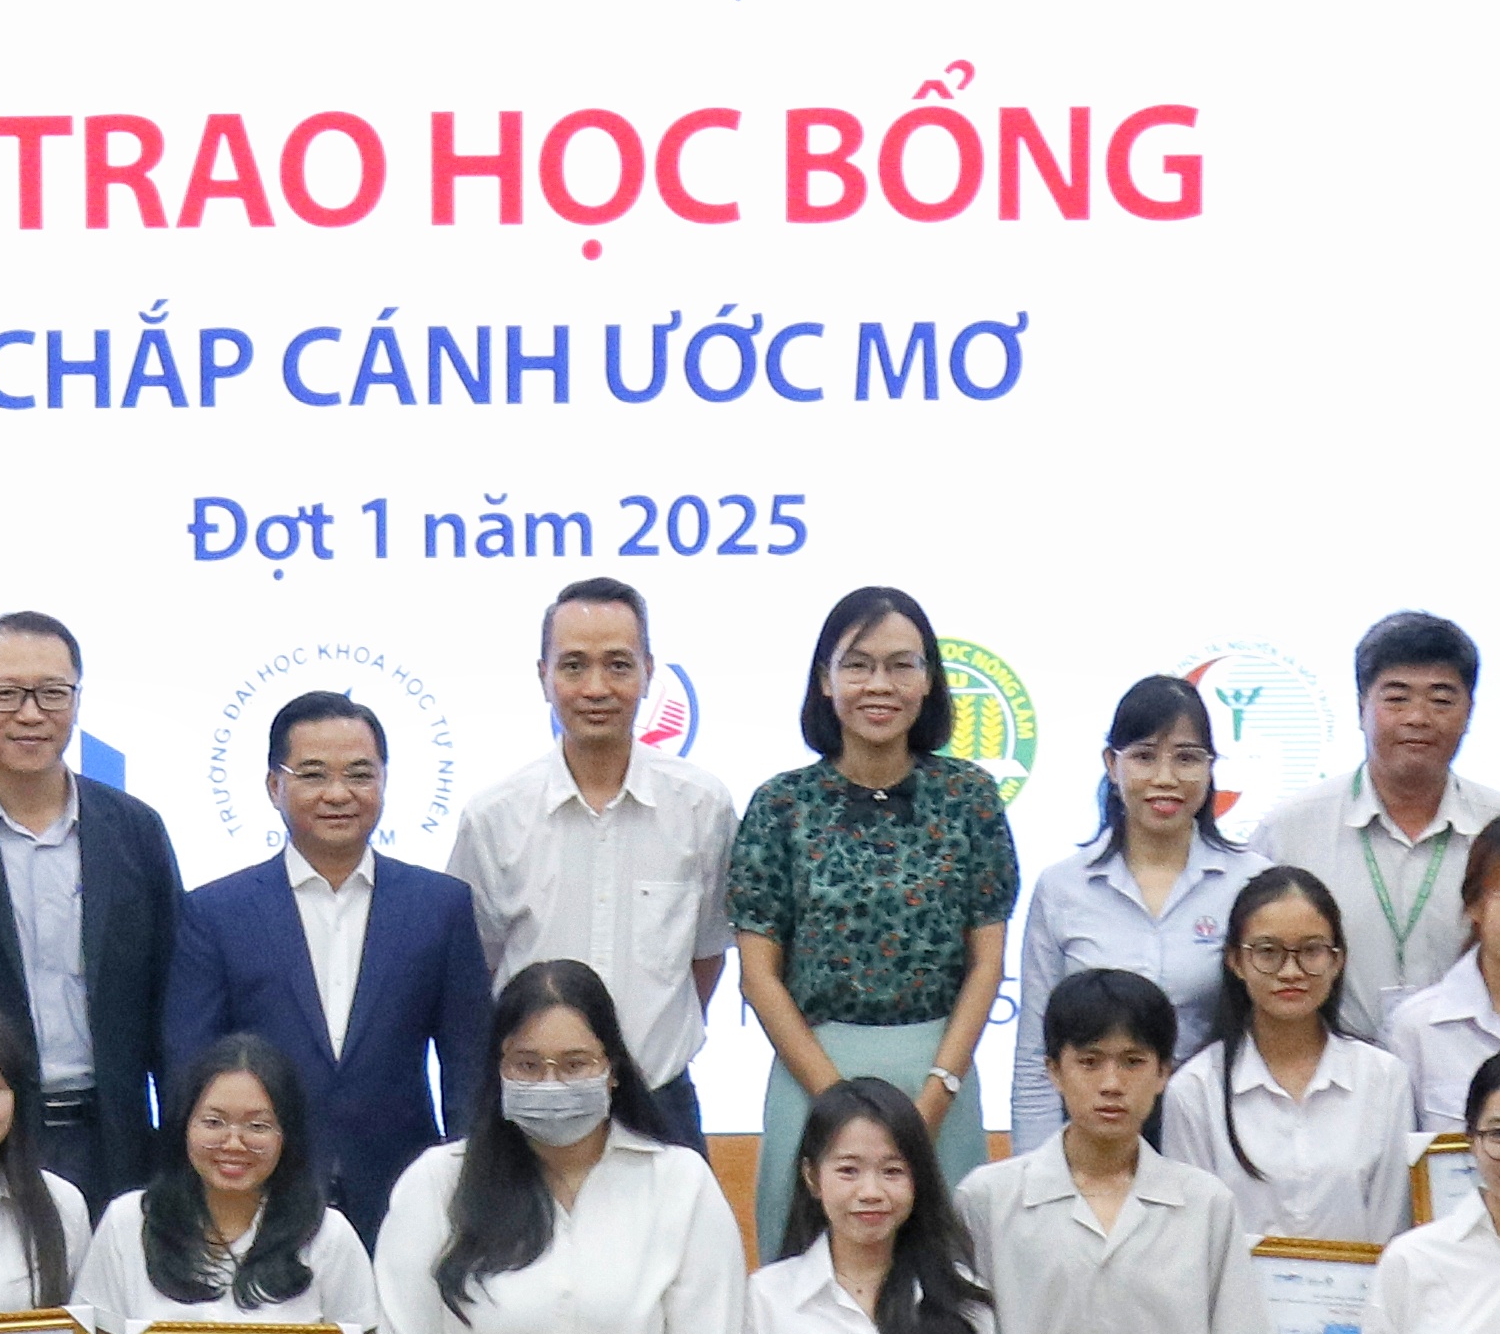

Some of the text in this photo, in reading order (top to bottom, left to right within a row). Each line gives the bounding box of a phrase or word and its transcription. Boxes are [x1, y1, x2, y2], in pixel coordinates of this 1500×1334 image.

[429, 107, 743, 262] HỌC
[784, 58, 1204, 225] BỔNG
[281, 306, 571, 408] CÁNH
[603, 302, 826, 405] ƯỚC
[853, 310, 1030, 402] MƠ
[186, 492, 809, 582] Đợt 1 năm 2025
[256, 647, 308, 683] HỌC
[317, 643, 386, 671] KHOA
[391, 665, 437, 710] HỌC
[222, 680, 257, 721] ĐẠI
[207, 727, 243, 838] TRƯỜNG
[420, 759, 456, 834] NHIÊN
